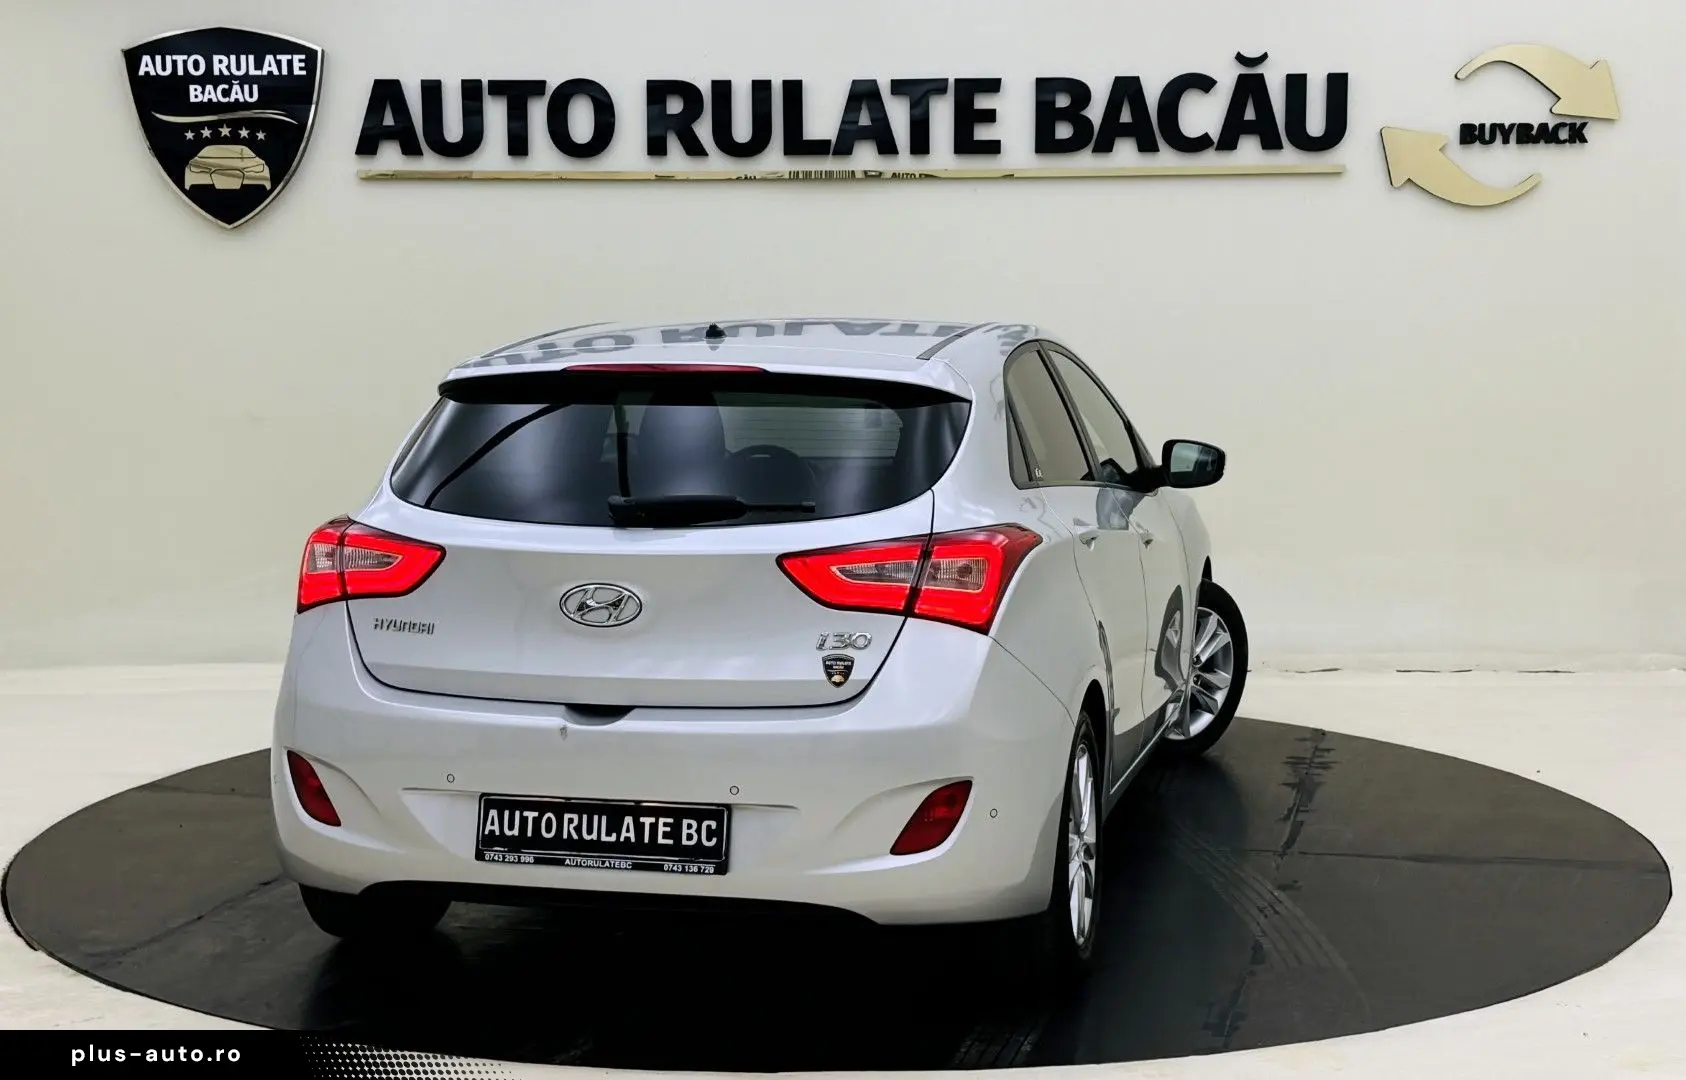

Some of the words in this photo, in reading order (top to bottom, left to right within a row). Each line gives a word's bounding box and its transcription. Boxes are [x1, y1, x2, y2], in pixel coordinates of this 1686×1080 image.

[139, 54, 205, 77] AUTO
[212, 54, 307, 77] RULATE
[188, 79, 259, 103] BACĂU
[355, 77, 616, 160] AUTO
[646, 77, 1002, 159] RULATE
[1035, 52, 1349, 155] BACĂU
[1459, 121, 1589, 145] BUYBACK
[373, 617, 435, 635] HYUNDAI
[484, 808, 557, 839] AUTO
[562, 812, 674, 845] RULATE
[681, 818, 717, 847] BC
[564, 858, 632, 869] AUTORULATEBC
